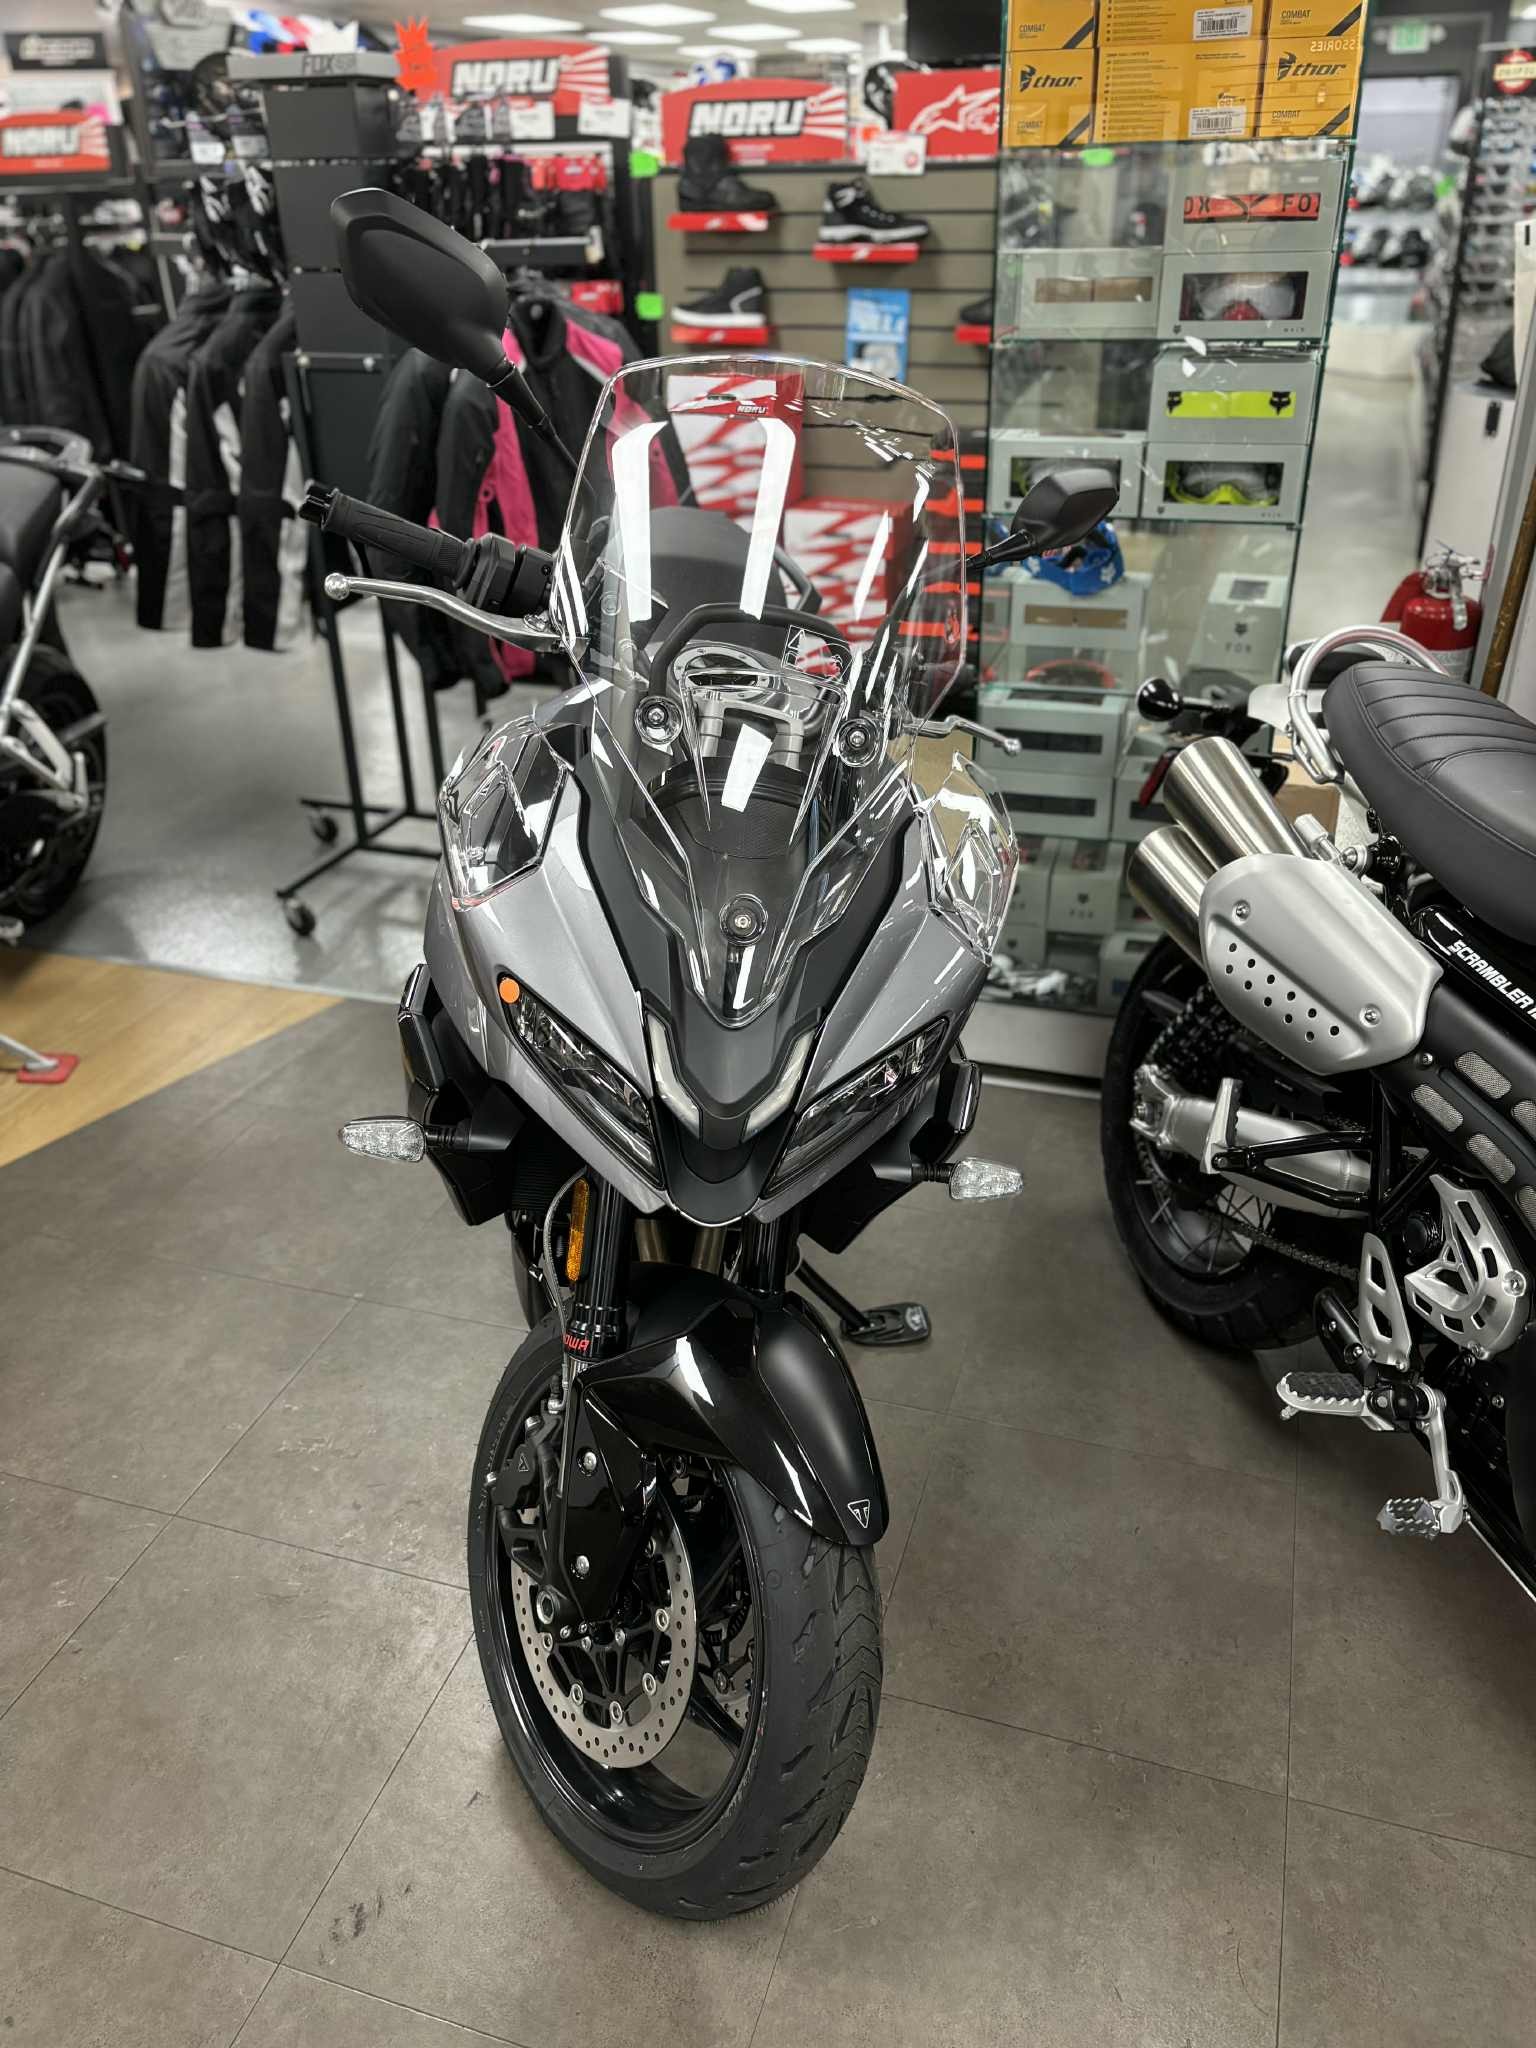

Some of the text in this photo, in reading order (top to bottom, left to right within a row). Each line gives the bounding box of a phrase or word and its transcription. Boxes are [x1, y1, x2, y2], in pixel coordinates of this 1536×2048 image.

[1281, 9, 1311, 19] COMBAT
[1019, 24, 1046, 33] COMBAT
[452, 58, 560, 96] NORU
[1292, 63, 1346, 77] thor
[1033, 74, 1082, 89] thor
[689, 98, 807, 138] NORU
[1272, 110, 1301, 119] COMBAT
[736, 405, 767, 415] NORU
[1448, 939, 1534, 1010] SCRAMBLER
